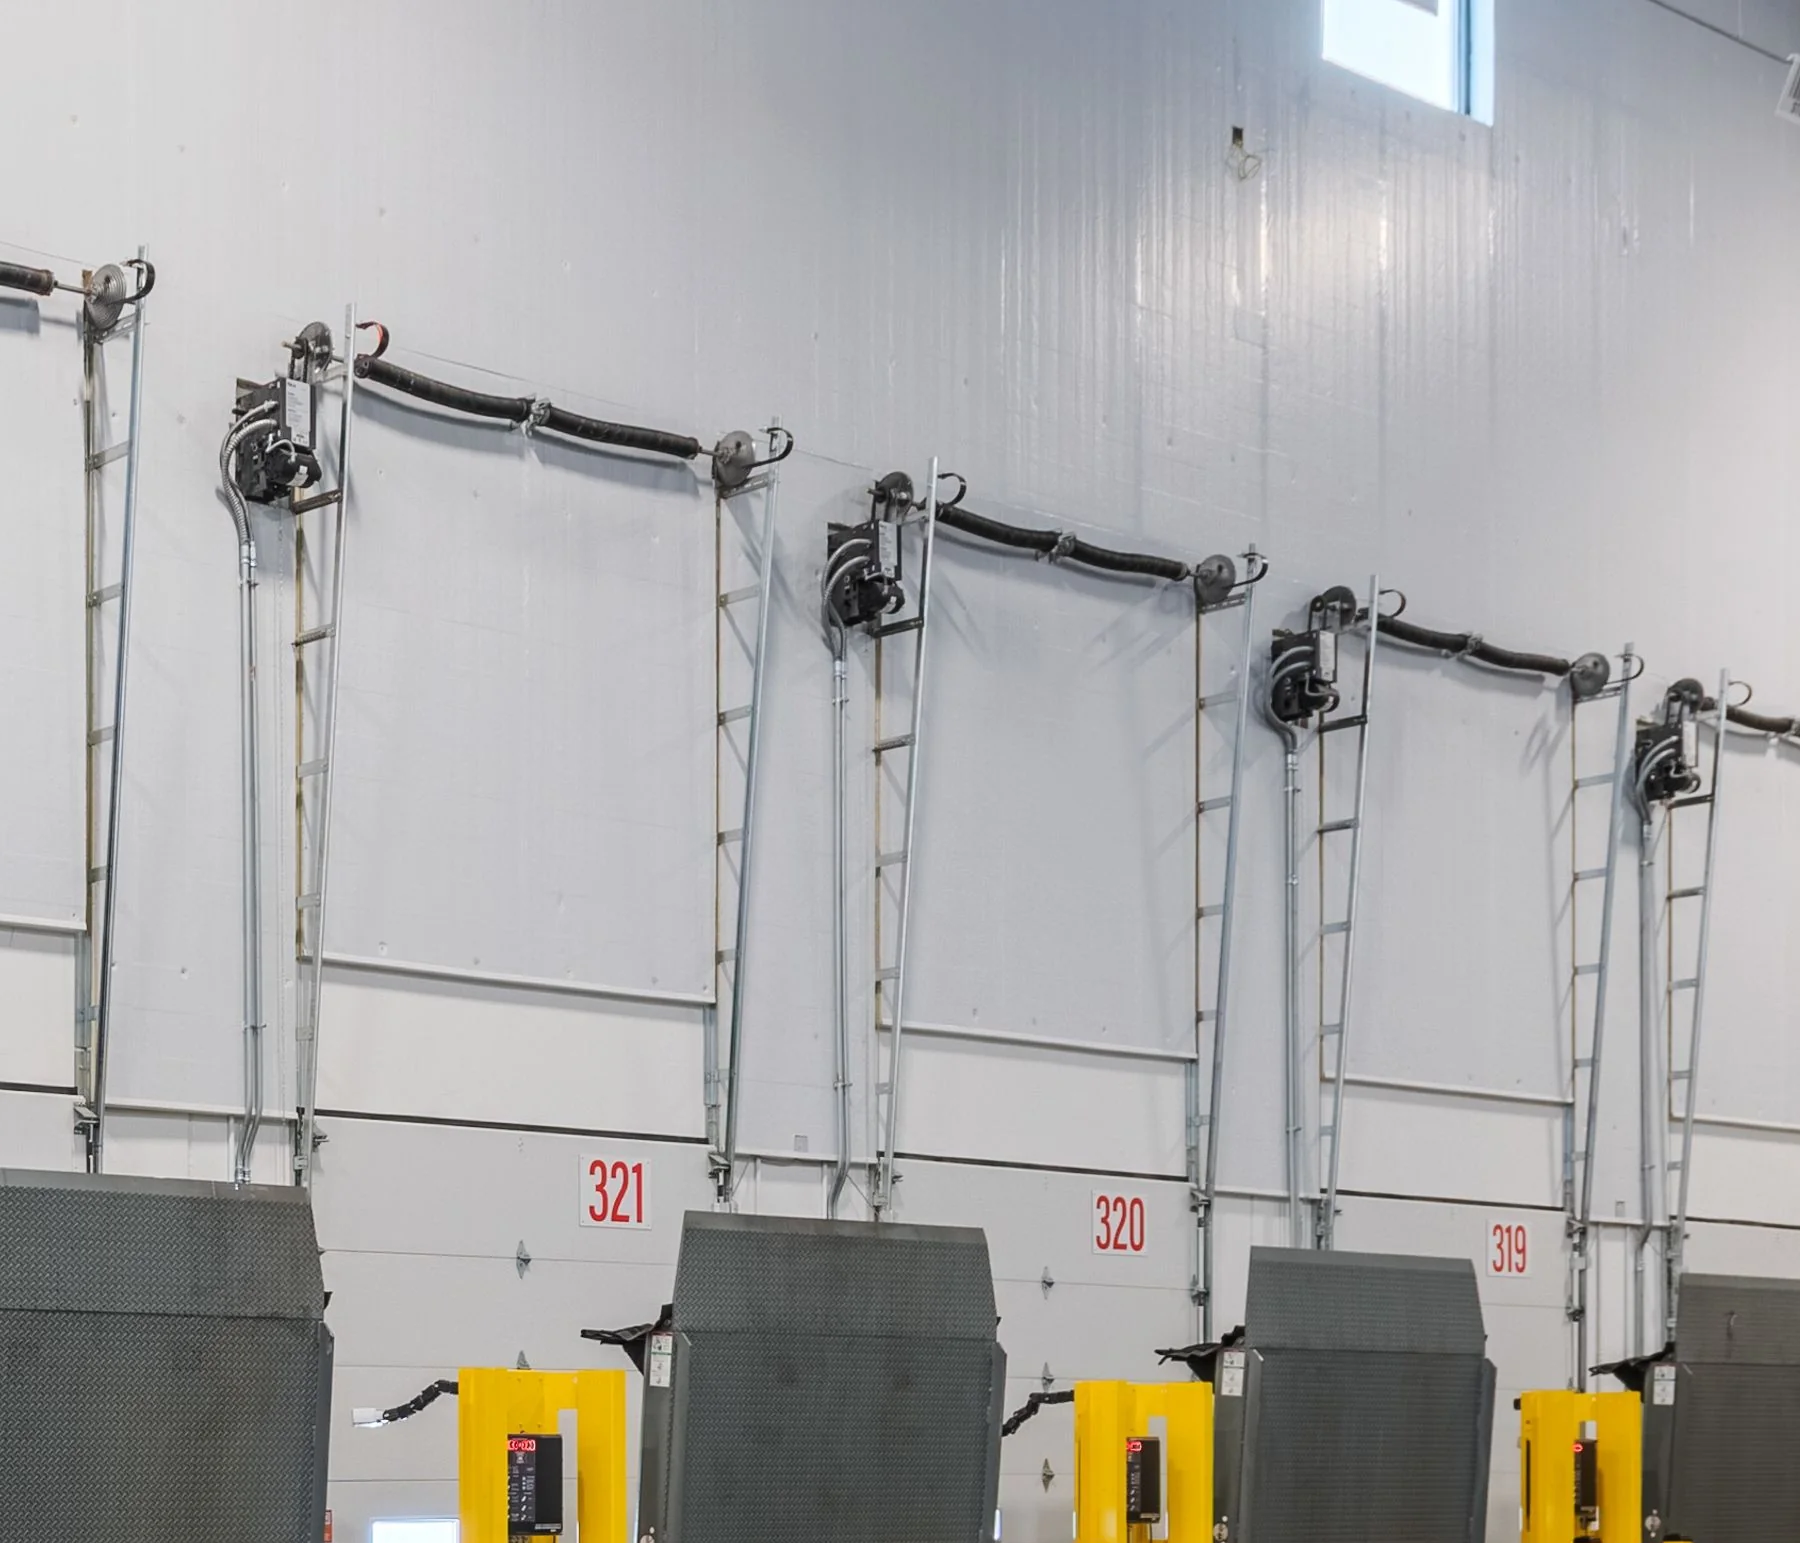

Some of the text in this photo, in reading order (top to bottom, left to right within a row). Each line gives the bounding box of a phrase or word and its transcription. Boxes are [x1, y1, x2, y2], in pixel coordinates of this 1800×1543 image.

[587, 1159, 645, 1224] 321
[1095, 1194, 1146, 1252] 320
[1492, 1224, 1528, 1273] 319
